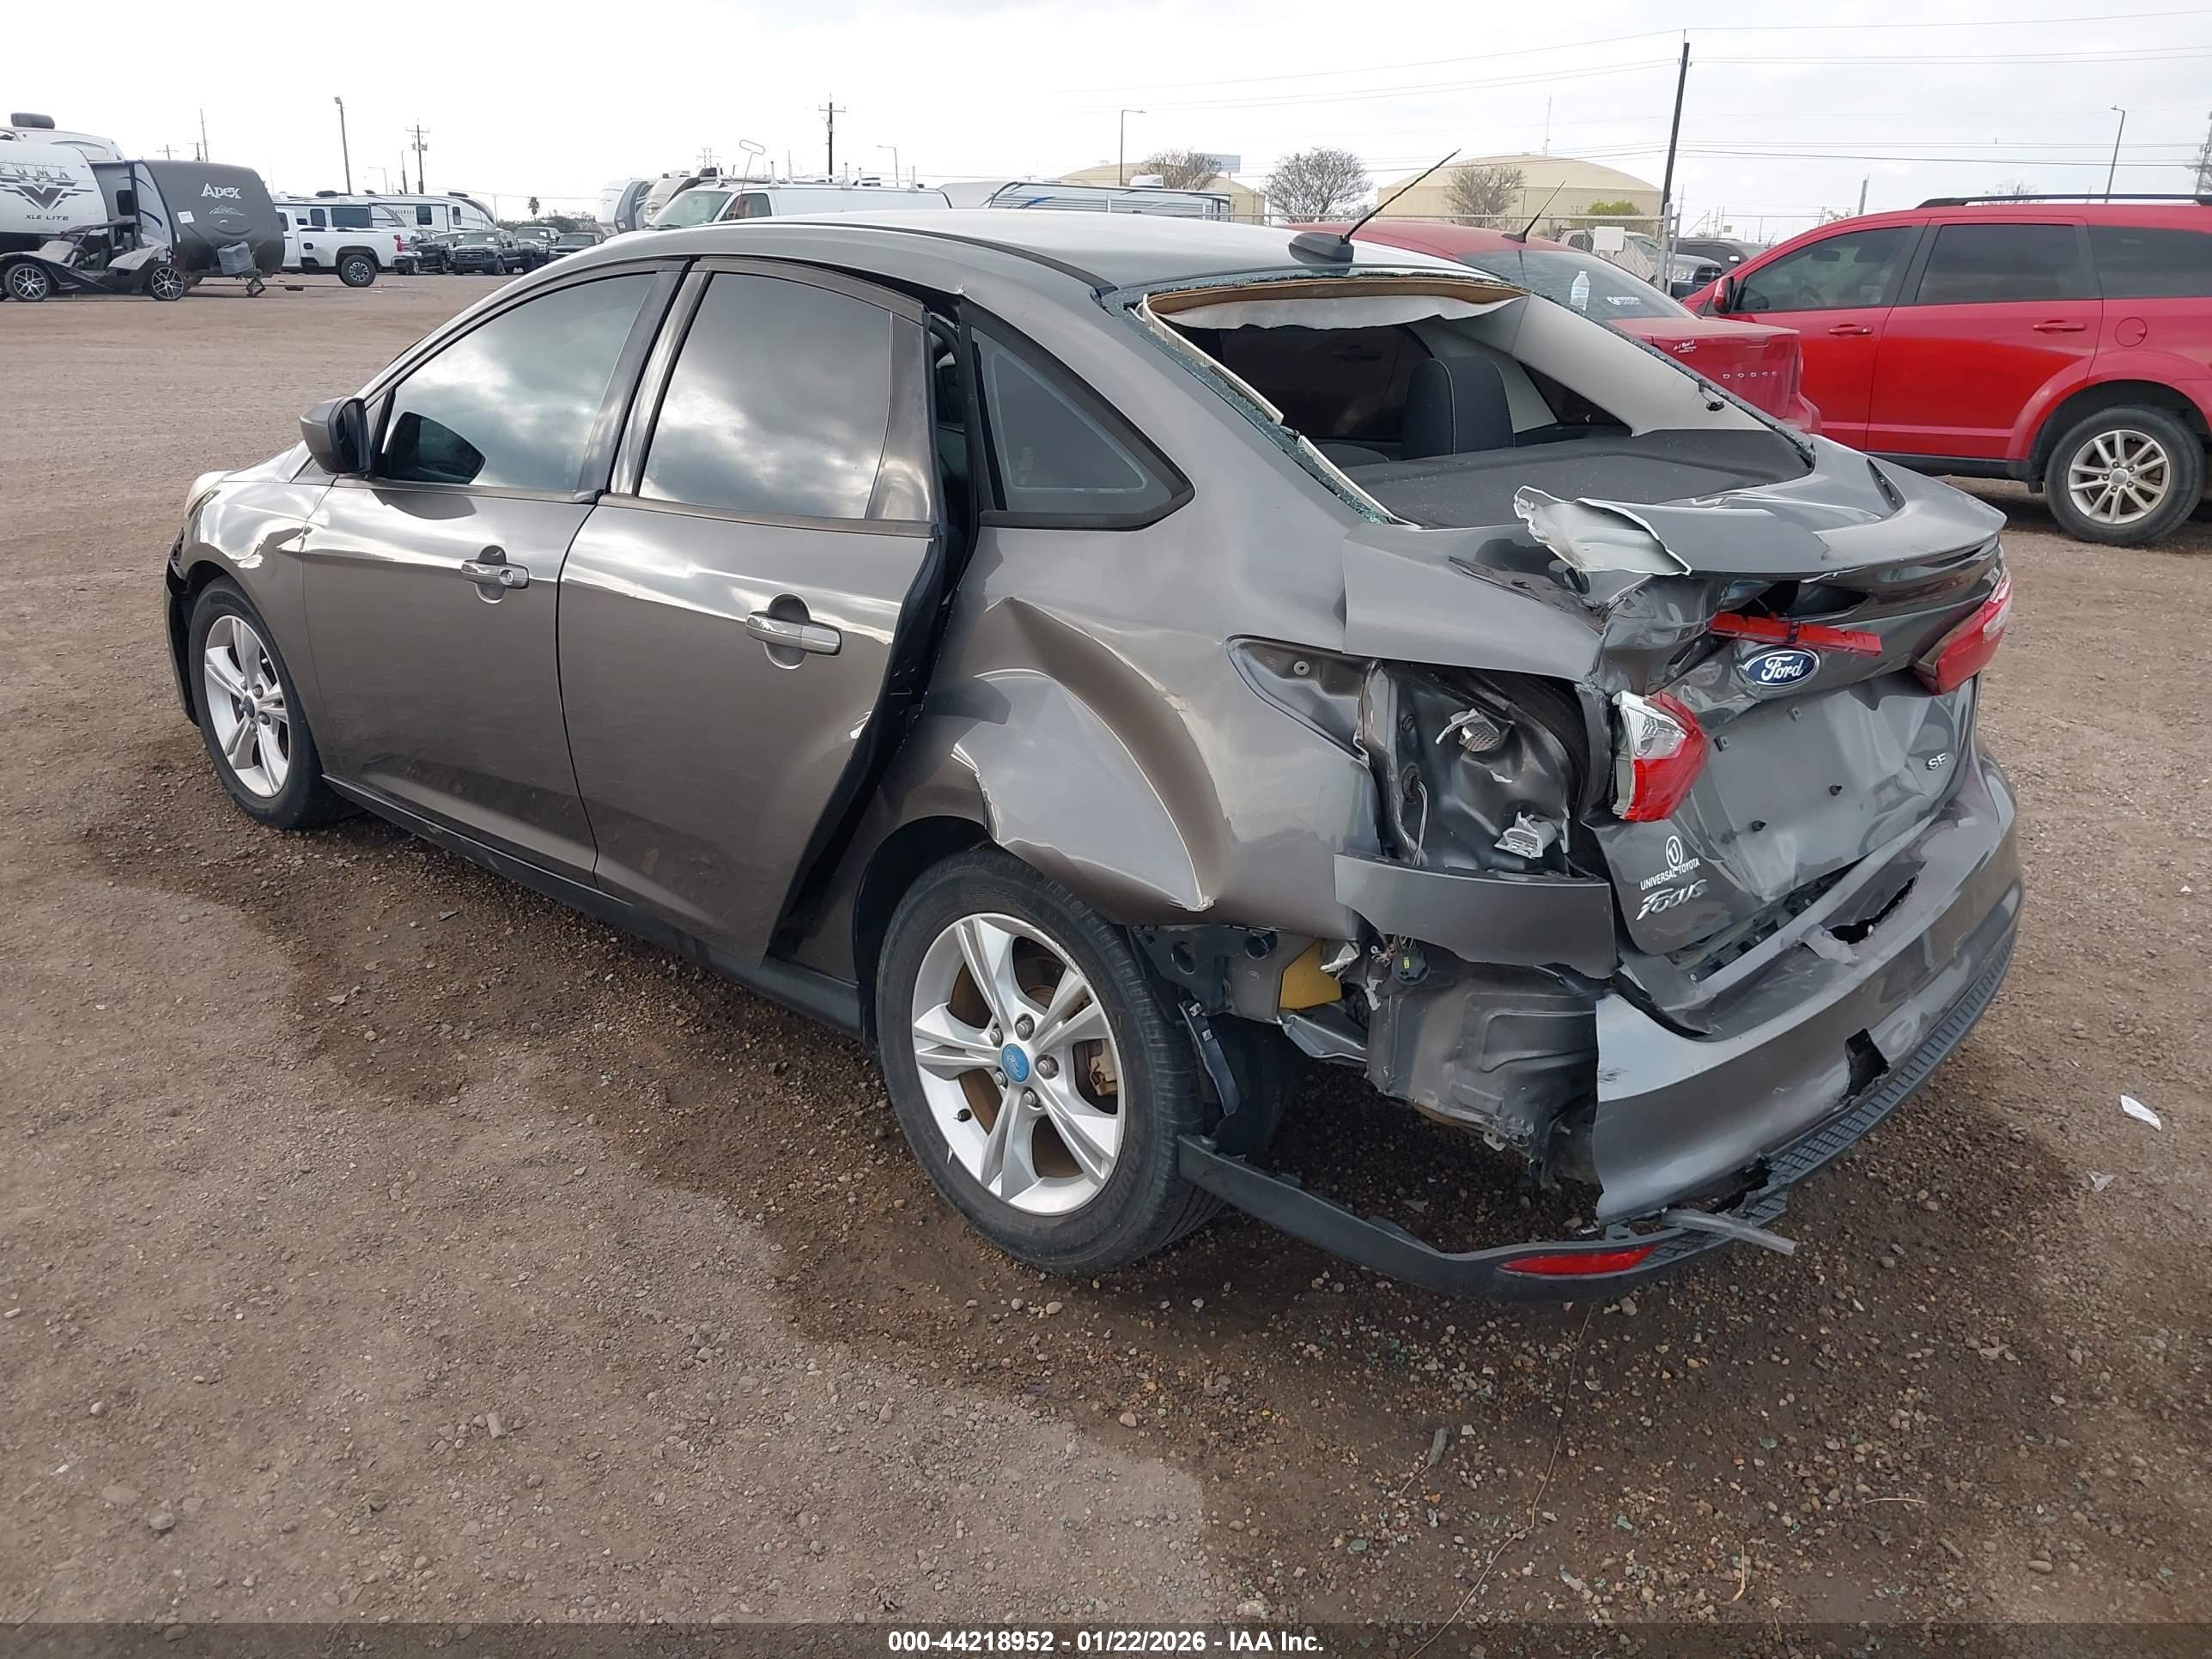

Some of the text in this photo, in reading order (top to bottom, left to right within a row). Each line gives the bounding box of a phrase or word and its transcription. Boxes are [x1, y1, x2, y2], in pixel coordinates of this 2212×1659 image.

[200, 182, 243, 199] Apex
[1761, 655, 1804, 681] Ford
[1926, 752, 1947, 770] SE
[1640, 857, 1700, 890] UNIVERSAL TOYOTA
[1635, 878, 1707, 921] Focus
